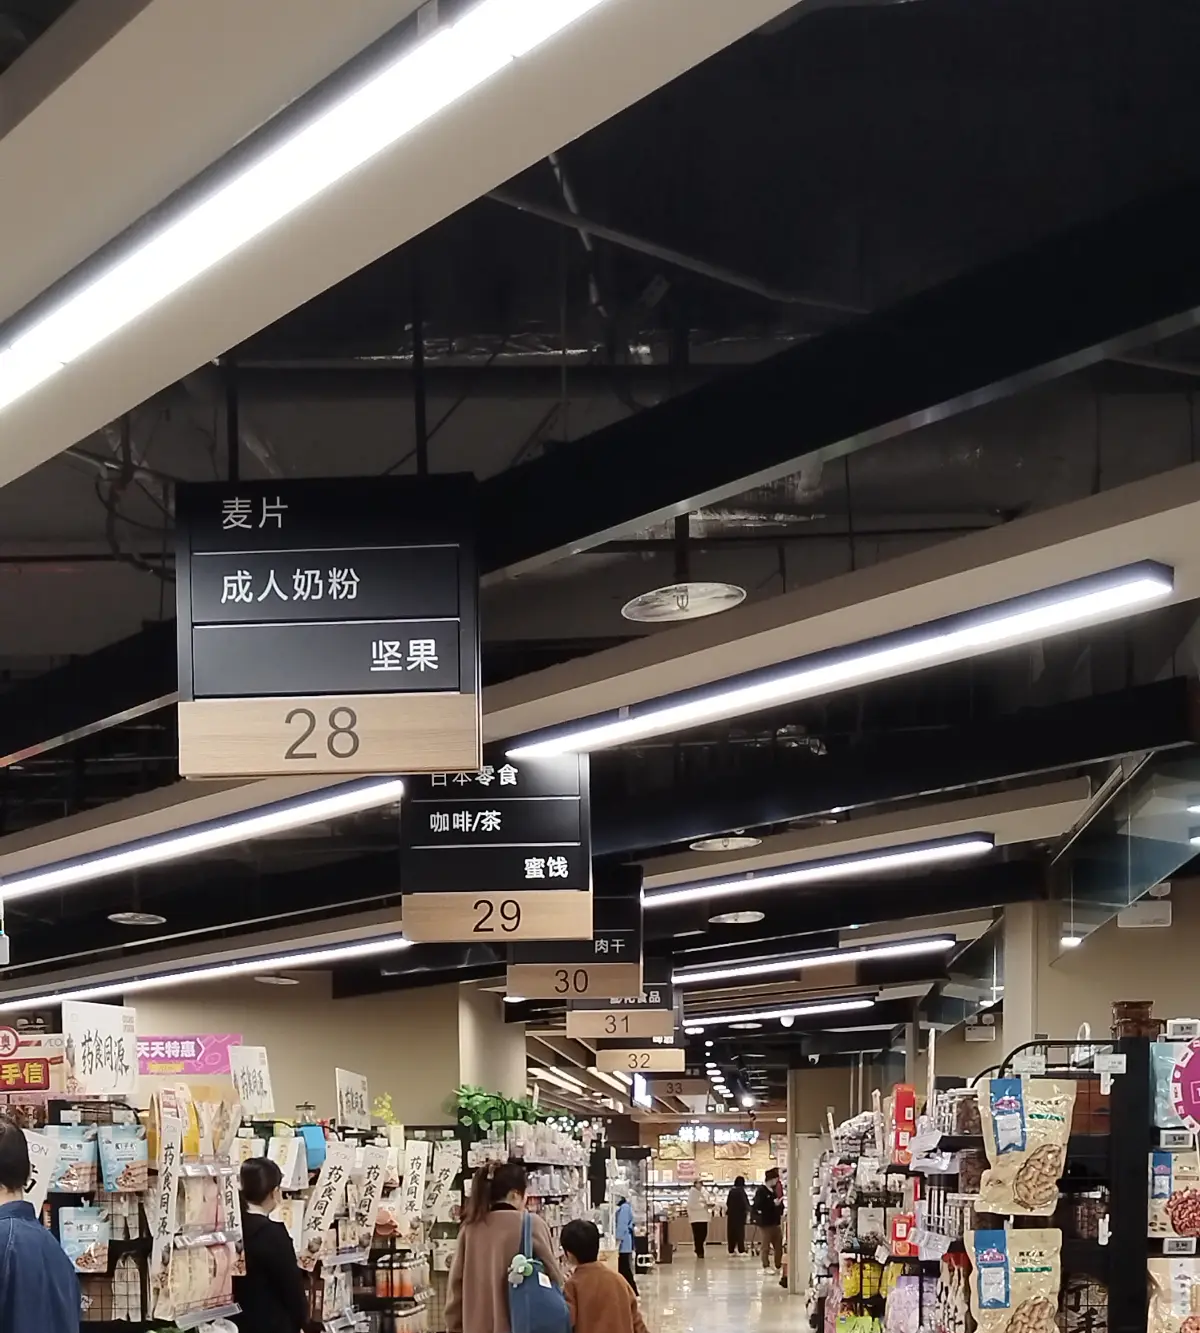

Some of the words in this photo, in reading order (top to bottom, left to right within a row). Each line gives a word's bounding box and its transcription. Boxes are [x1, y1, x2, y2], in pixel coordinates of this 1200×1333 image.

[220, 496, 289, 530] 麦片
[220, 568, 361, 604] 成人奶粉
[370, 639, 440, 672] 坚果
[283, 706, 361, 760] 28
[430, 764, 519, 788] 日本零食
[430, 810, 502, 832] 咖啡/茶
[524, 857, 569, 879] 蜜饯
[473, 899, 522, 933] 29
[594, 938, 626, 954] 肉干
[554, 968, 589, 994] 30
[604, 1014, 630, 1034] 31
[137, 1040, 197, 1059] 天天特惠
[627, 1053, 651, 1069] 32
[666, 1082, 683, 1094] 33
[305, 1165, 344, 1232] 药食同源
[425, 1167, 451, 1209] 药食同
